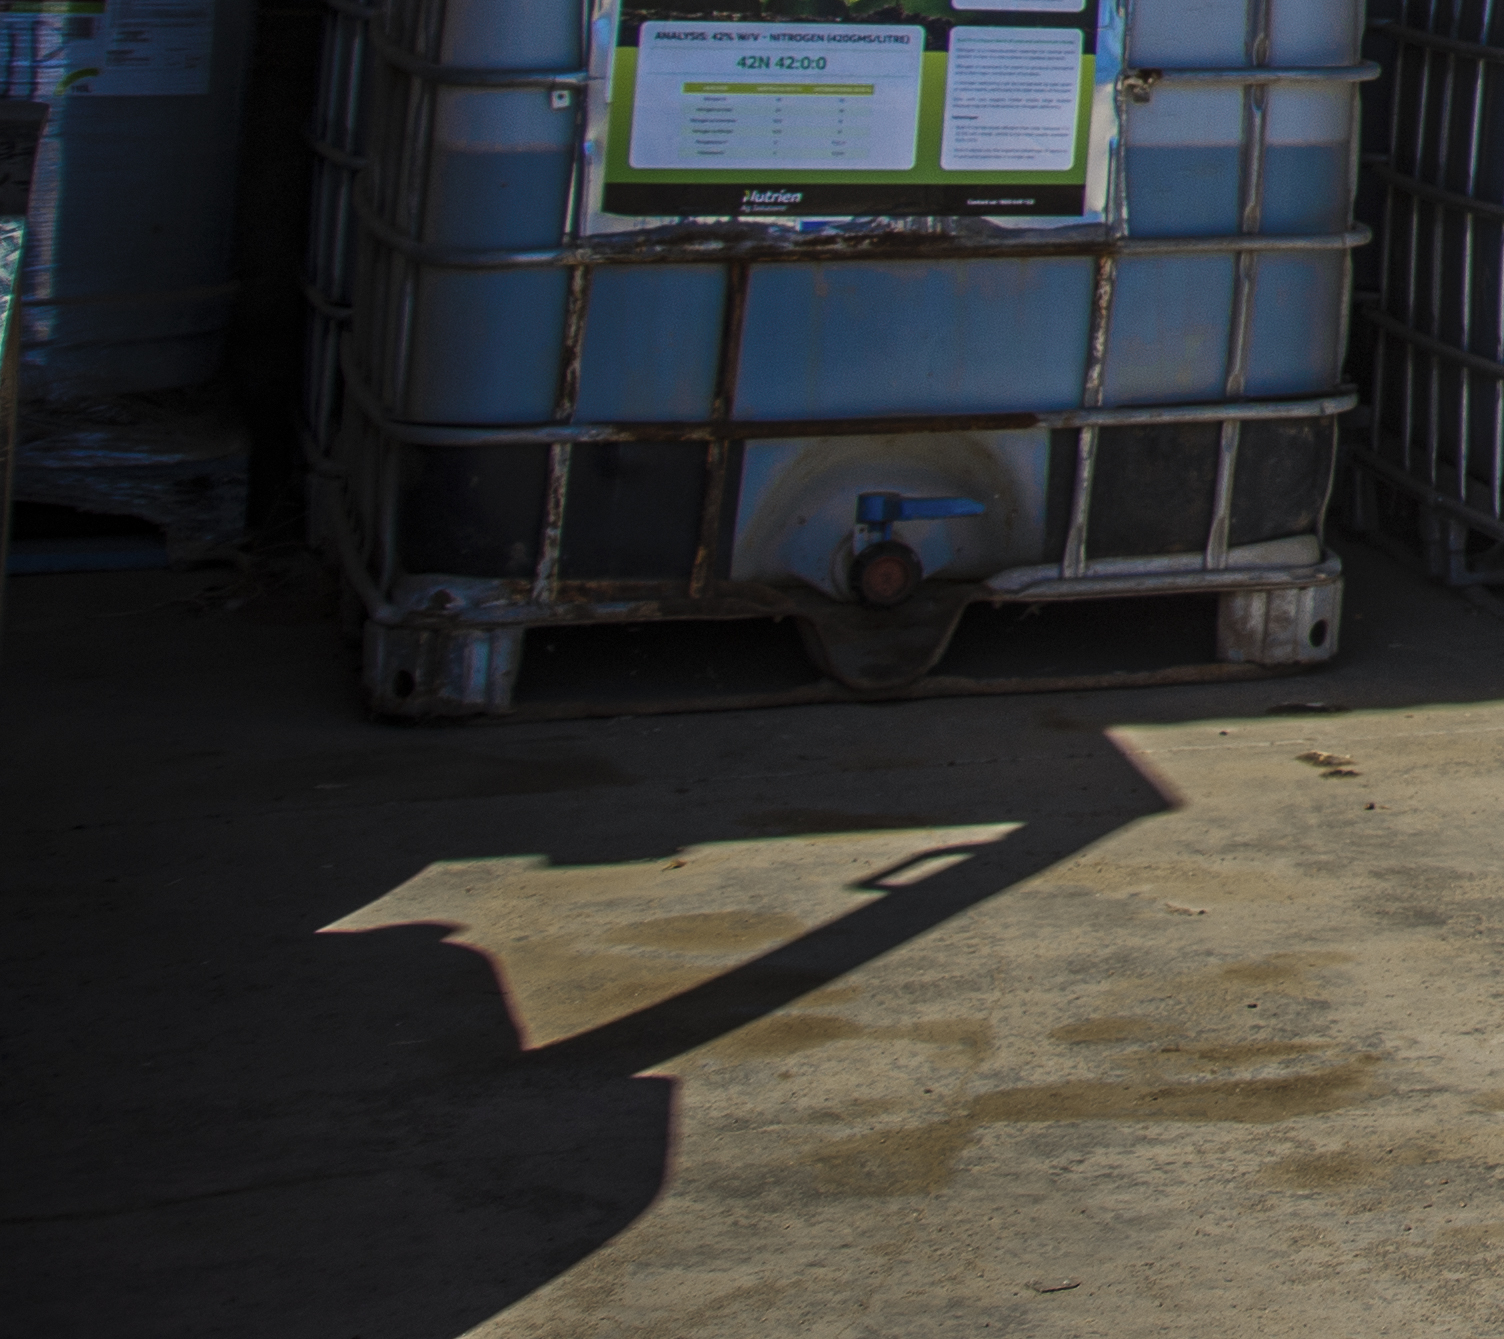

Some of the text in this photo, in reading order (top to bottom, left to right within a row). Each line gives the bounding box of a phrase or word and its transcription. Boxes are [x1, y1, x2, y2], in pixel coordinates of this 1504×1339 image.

[769, 33, 824, 43] NITROGEN
[737, 56, 827, 70] 42N 42:0:0
